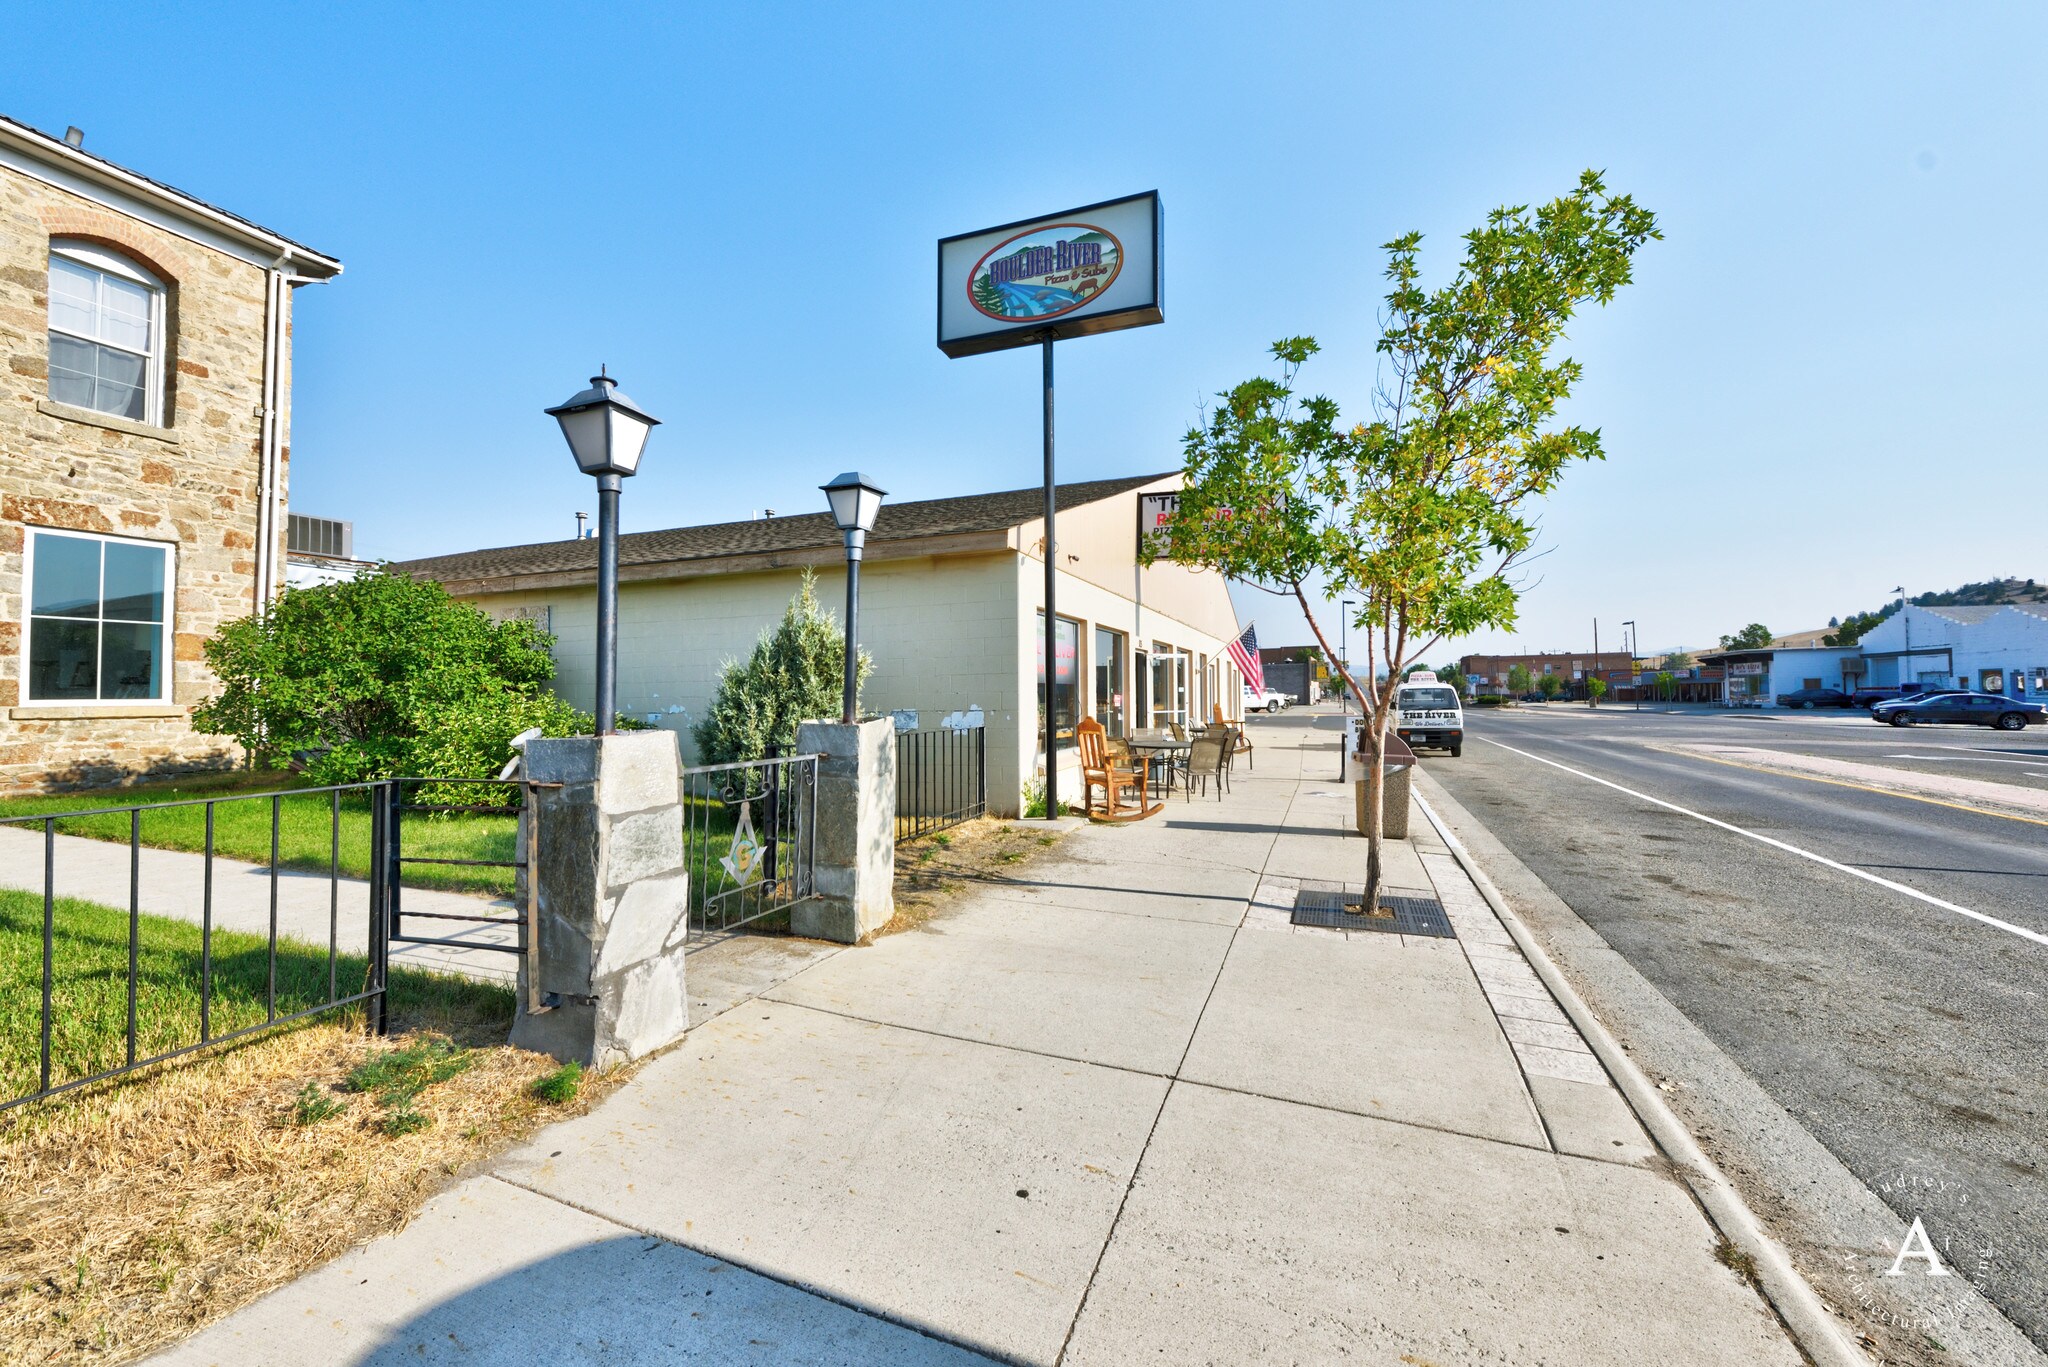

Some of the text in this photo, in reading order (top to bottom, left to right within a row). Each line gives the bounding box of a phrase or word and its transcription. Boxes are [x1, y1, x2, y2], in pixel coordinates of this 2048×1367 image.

[989, 239, 1102, 284] BOULDER RIVER
[1044, 264, 1108, 285] Pizza & Subs
